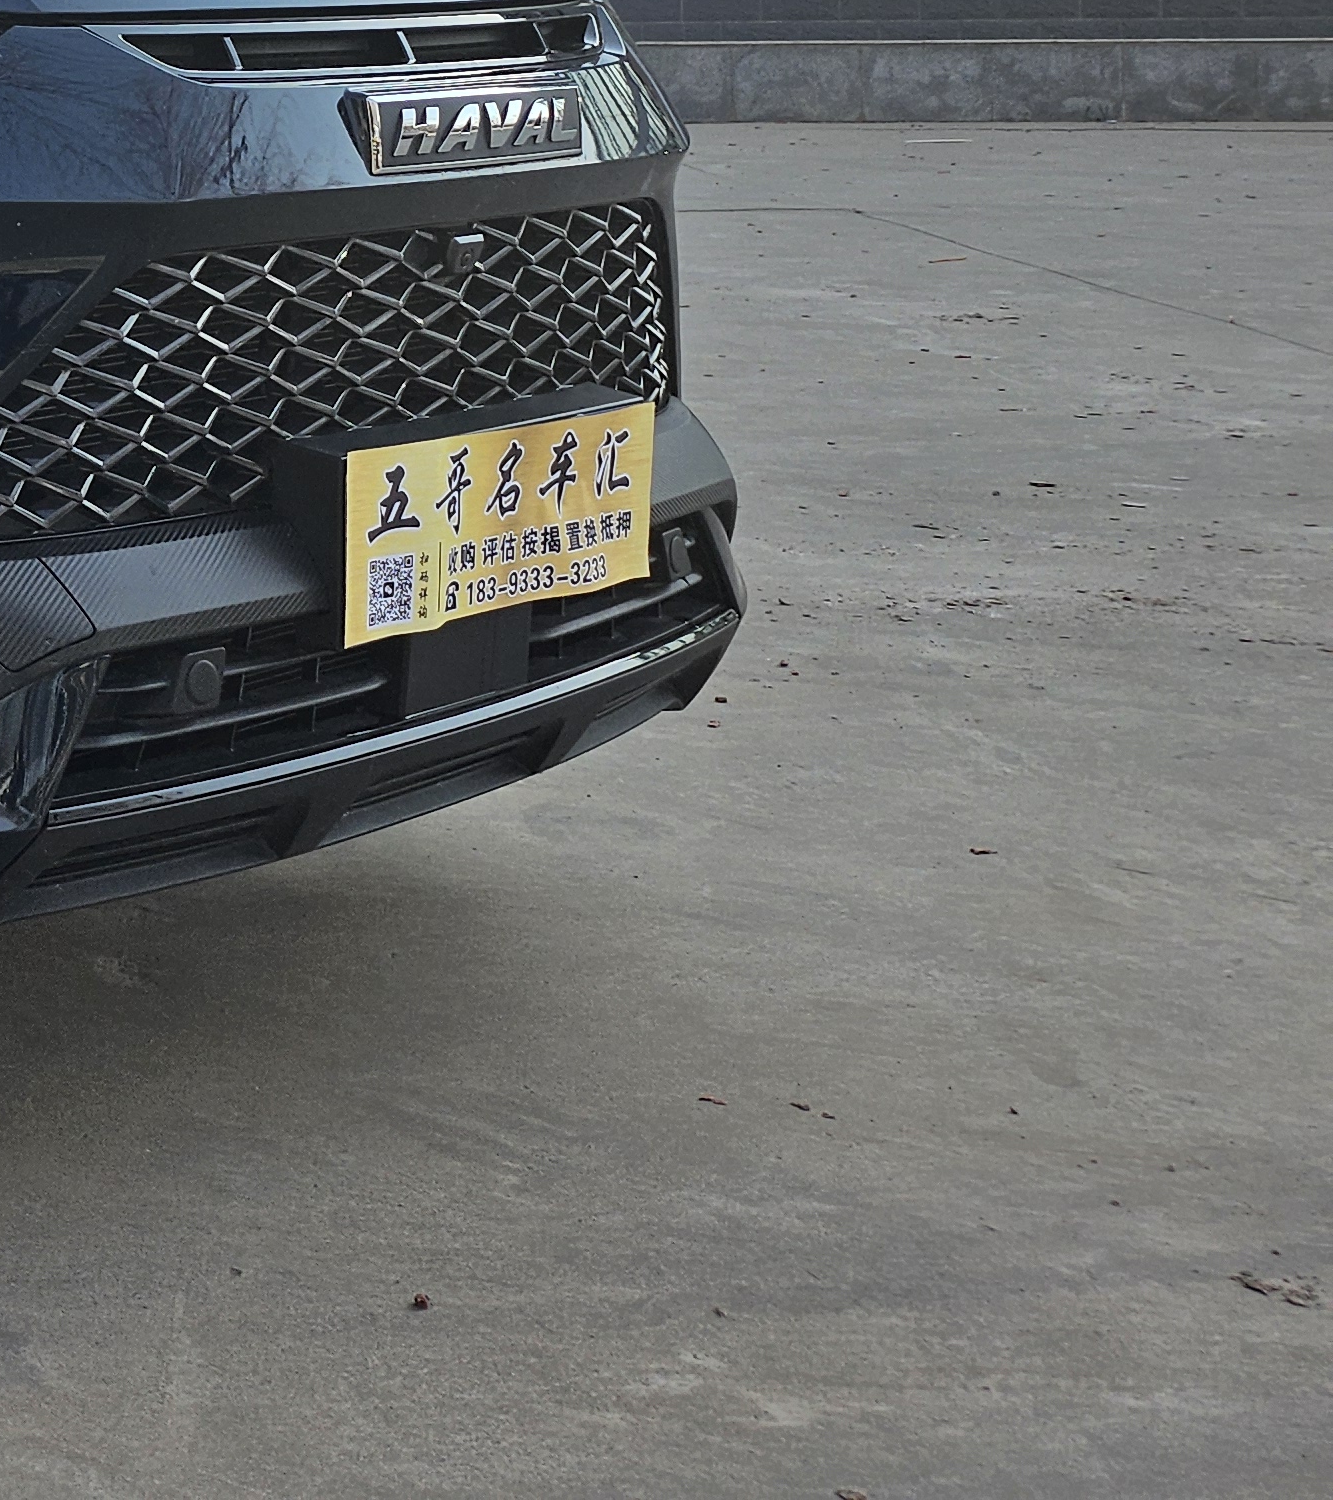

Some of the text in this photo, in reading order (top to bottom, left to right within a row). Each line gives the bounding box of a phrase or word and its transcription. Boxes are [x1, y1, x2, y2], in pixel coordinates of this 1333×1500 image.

[393, 98, 579, 158] HAVAL
[367, 428, 631, 544] 五哥名车汇
[466, 554, 607, 606] 183-9333-3233
